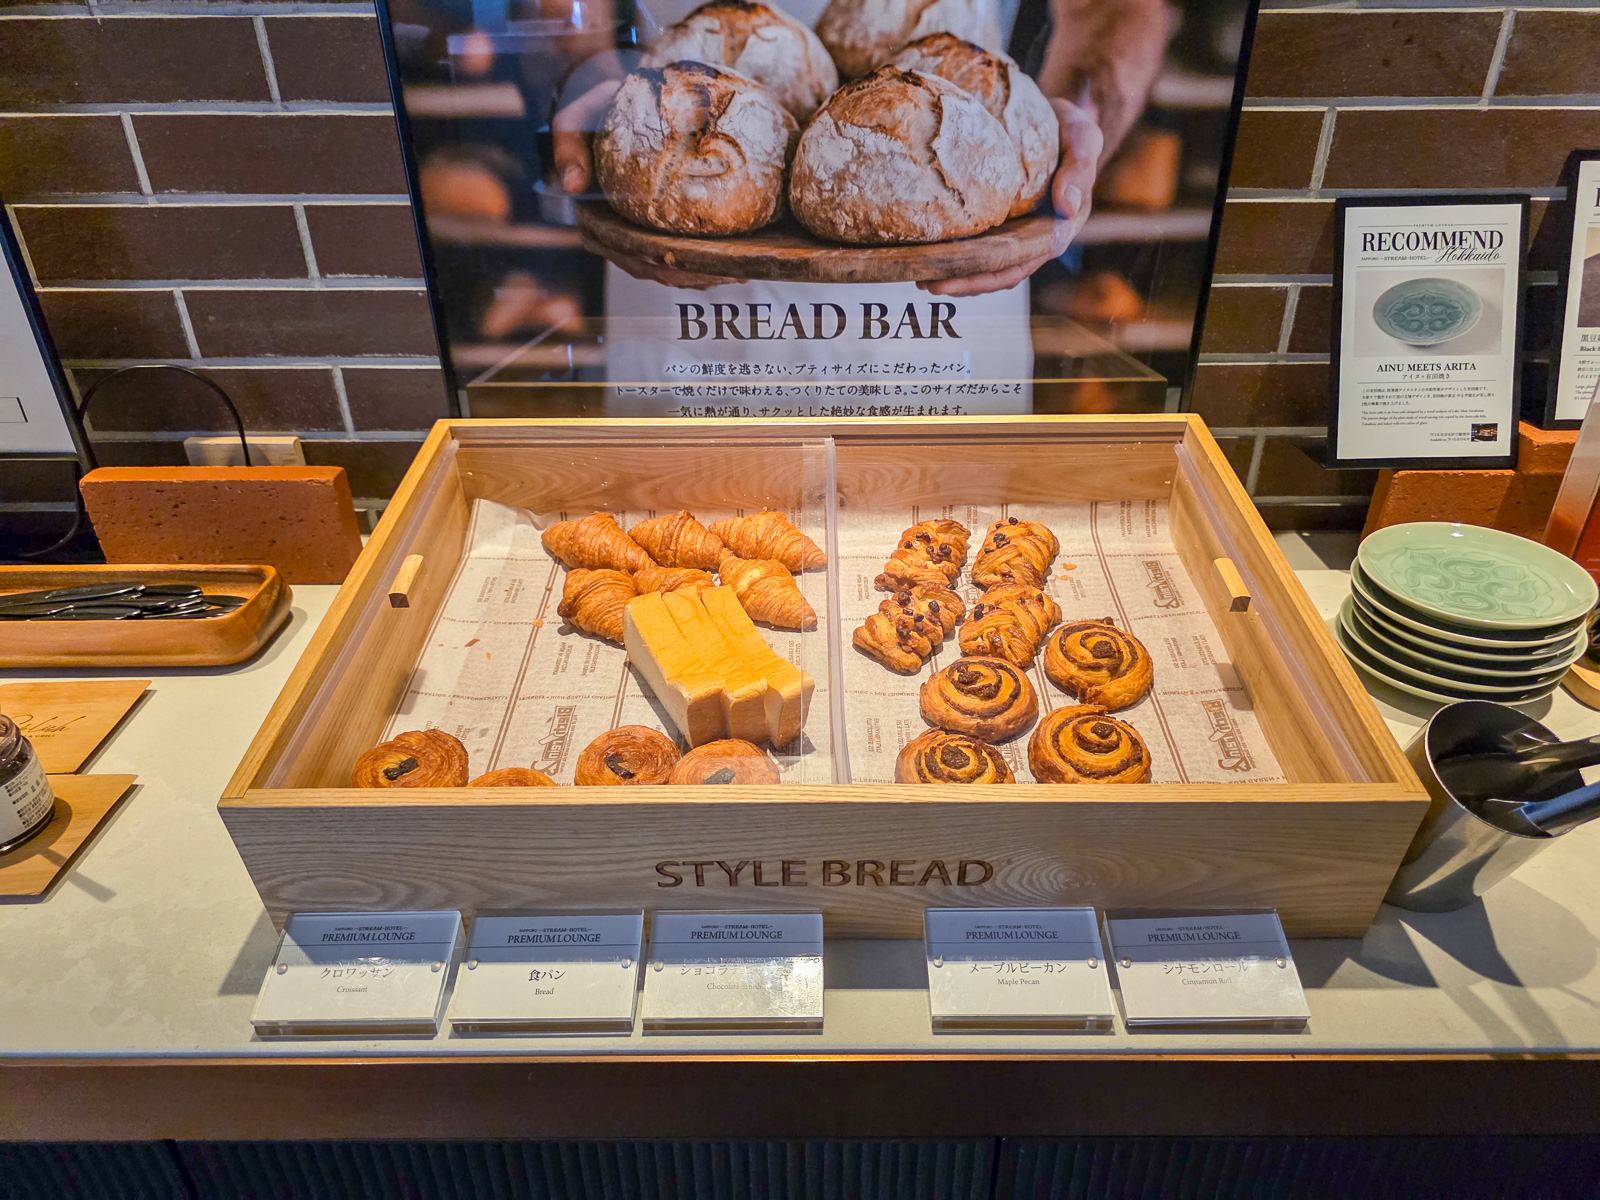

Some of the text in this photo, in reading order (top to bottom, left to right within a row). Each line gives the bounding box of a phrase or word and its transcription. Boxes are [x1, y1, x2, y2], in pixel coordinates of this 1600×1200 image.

[1361, 230, 1503, 252] RECOMMEND
[1435, 244, 1502, 264] Hokkaido
[674, 301, 962, 341] BREAD BAR
[1376, 361, 1477, 374] AINU MEETS ARITA
[654, 859, 995, 888] STYLE BREAD
[321, 931, 416, 942] PREMIUM LOUNGE
[507, 933, 601, 944] PREMIUM LOUNGE
[690, 930, 784, 940] PREMIUM LOUNGE
[966, 930, 1059, 940] PREMIUM LOUNGE
[1147, 931, 1241, 943] PREMIUM LOUNGE
[320, 967, 395, 979] クロワッサン
[1163, 961, 1249, 975] シナモンロール
[528, 969, 566, 982] 食パン
[1181, 977, 1233, 986] Cinnamon Roll
[706, 982, 740, 991] Chocolate
[997, 978, 1019, 987] Maple
